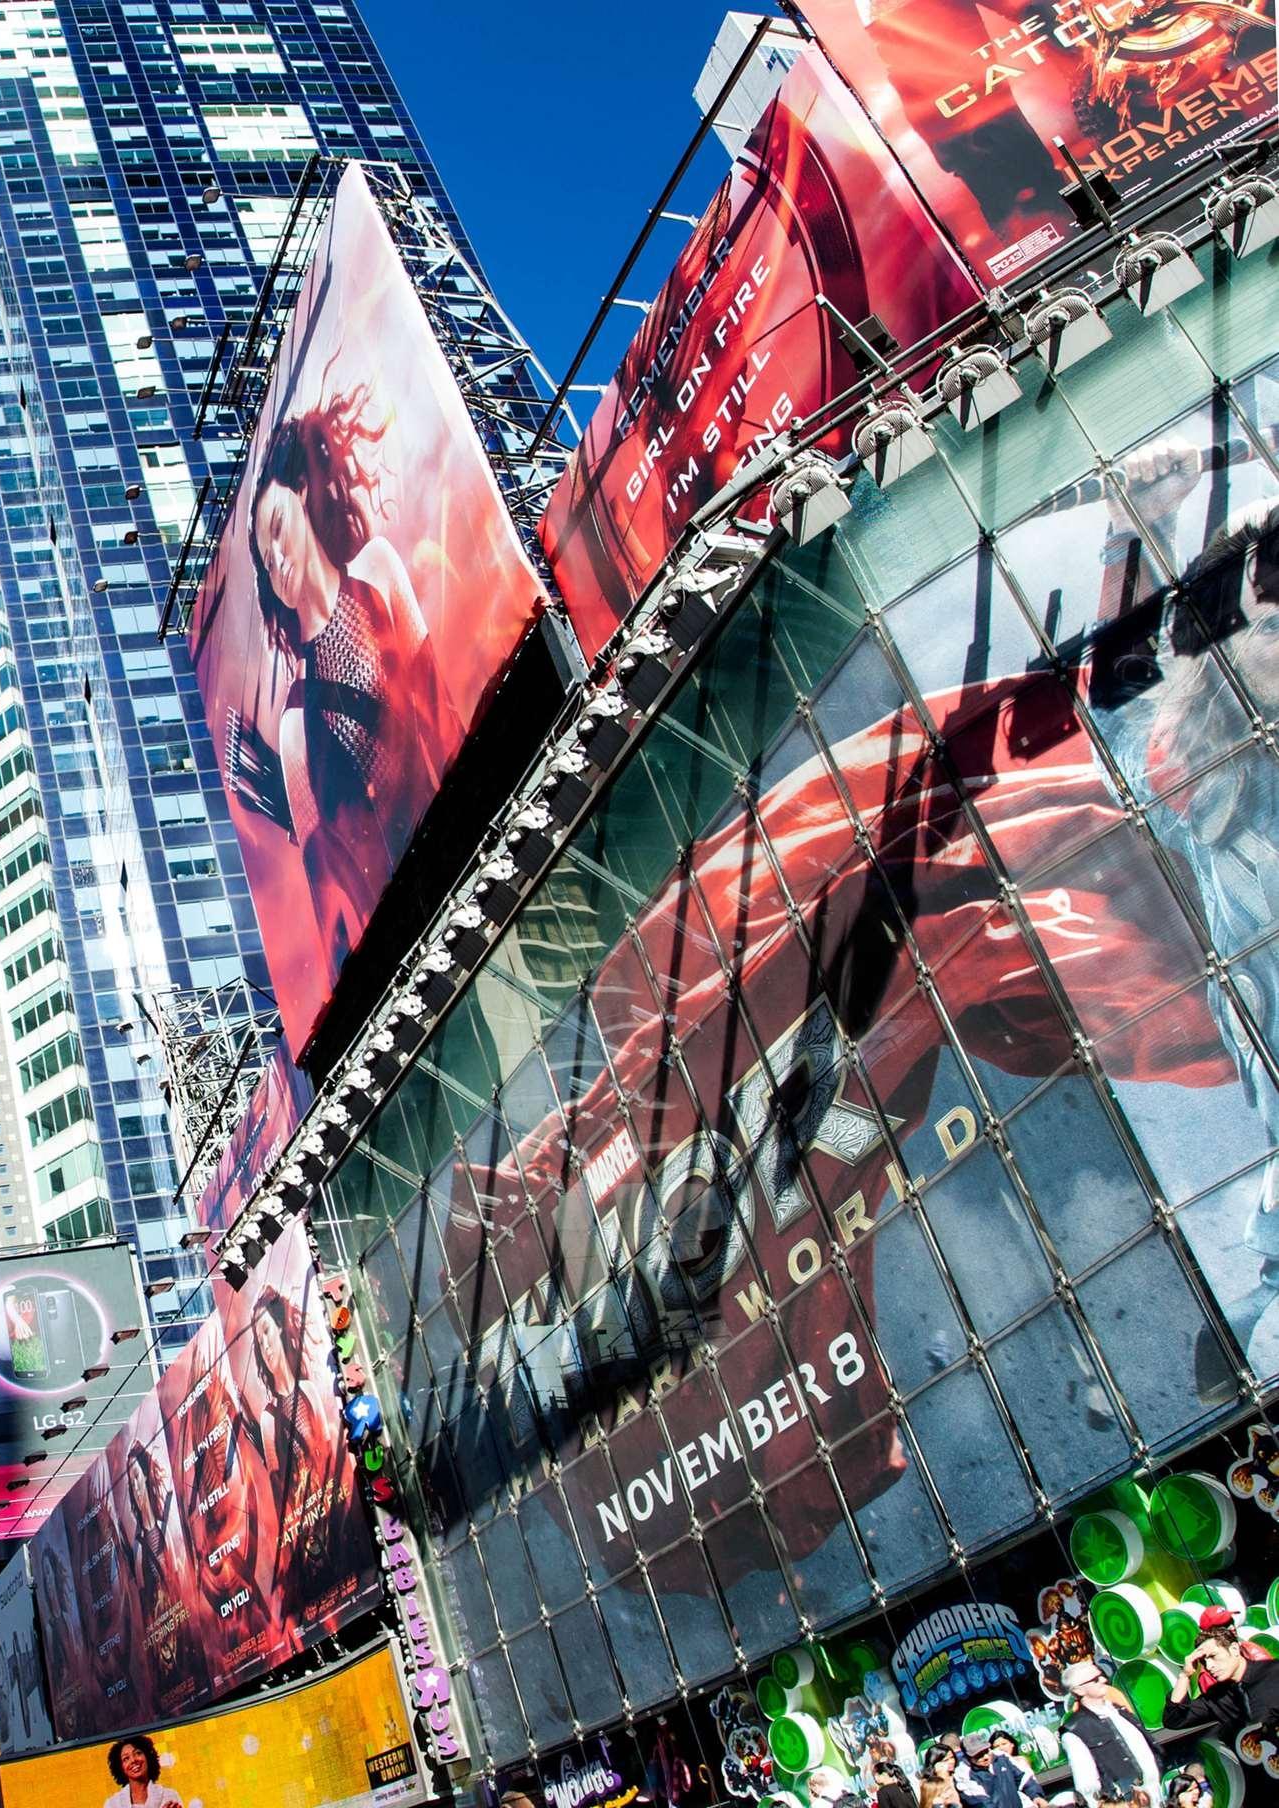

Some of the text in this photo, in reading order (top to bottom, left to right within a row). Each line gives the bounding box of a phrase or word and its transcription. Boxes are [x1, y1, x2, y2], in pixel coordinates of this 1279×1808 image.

[970, 13, 1047, 61] THE
[615, 235, 734, 440] REMEMBER
[626, 255, 772, 503] GIRL ON FIRE
[666, 350, 772, 514] I'M STILL
[583, 1126, 639, 1203] MARVEL
[177, 1371, 214, 1420] REMEMBER
[33, 1410, 87, 1432] LG G2
[596, 1362, 832, 1542] NOVEMBER
[828, 1331, 866, 1387] 8
[208, 1483, 231, 1510] STILL
[324, 1482, 351, 1510] FRE
[363, 1445, 394, 1502] US
[207, 1533, 242, 1569] BETTING
[220, 1588, 250, 1619] ON YOU
[383, 1517, 434, 1667] BABIES
[429, 1708, 459, 1757] US
[892, 1602, 1035, 1711] SKYLANDERS
[962, 1638, 1016, 1661] FORCE
[367, 1749, 405, 1773] WESTERN
[380, 1761, 407, 1782] UNION
